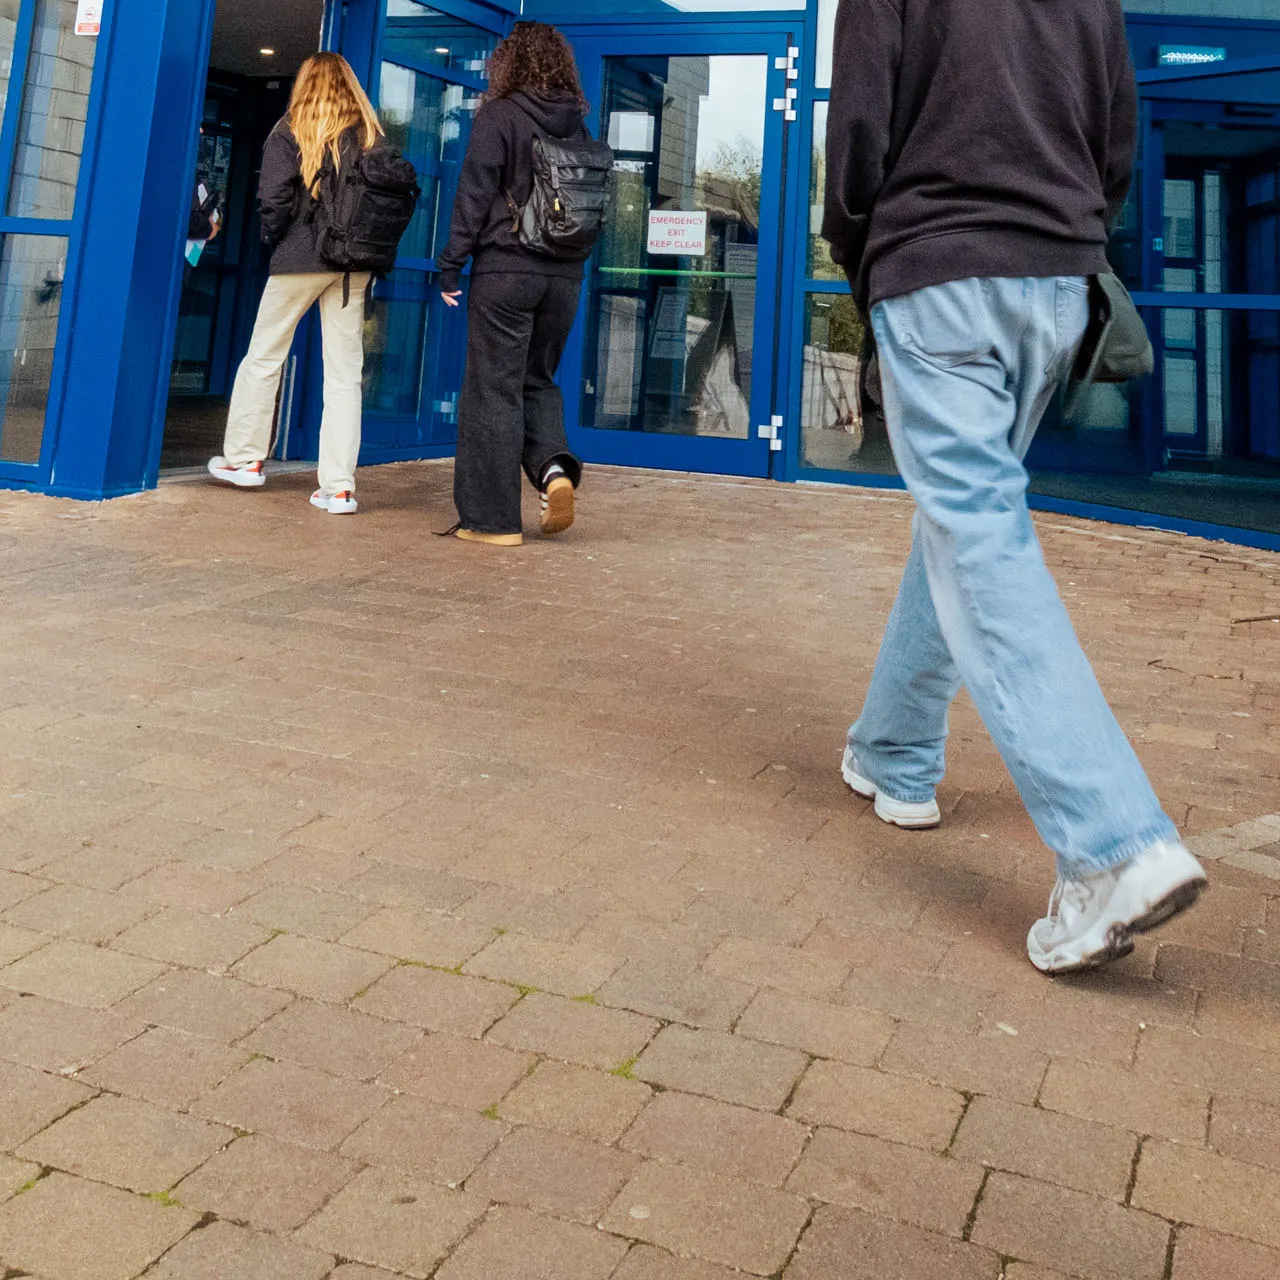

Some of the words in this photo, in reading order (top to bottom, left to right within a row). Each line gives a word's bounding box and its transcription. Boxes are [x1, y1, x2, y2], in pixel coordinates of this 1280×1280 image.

[650, 217, 703, 225] EMERGENCY
[649, 240, 671, 248] KEEP
[674, 240, 702, 249] CLEAR
